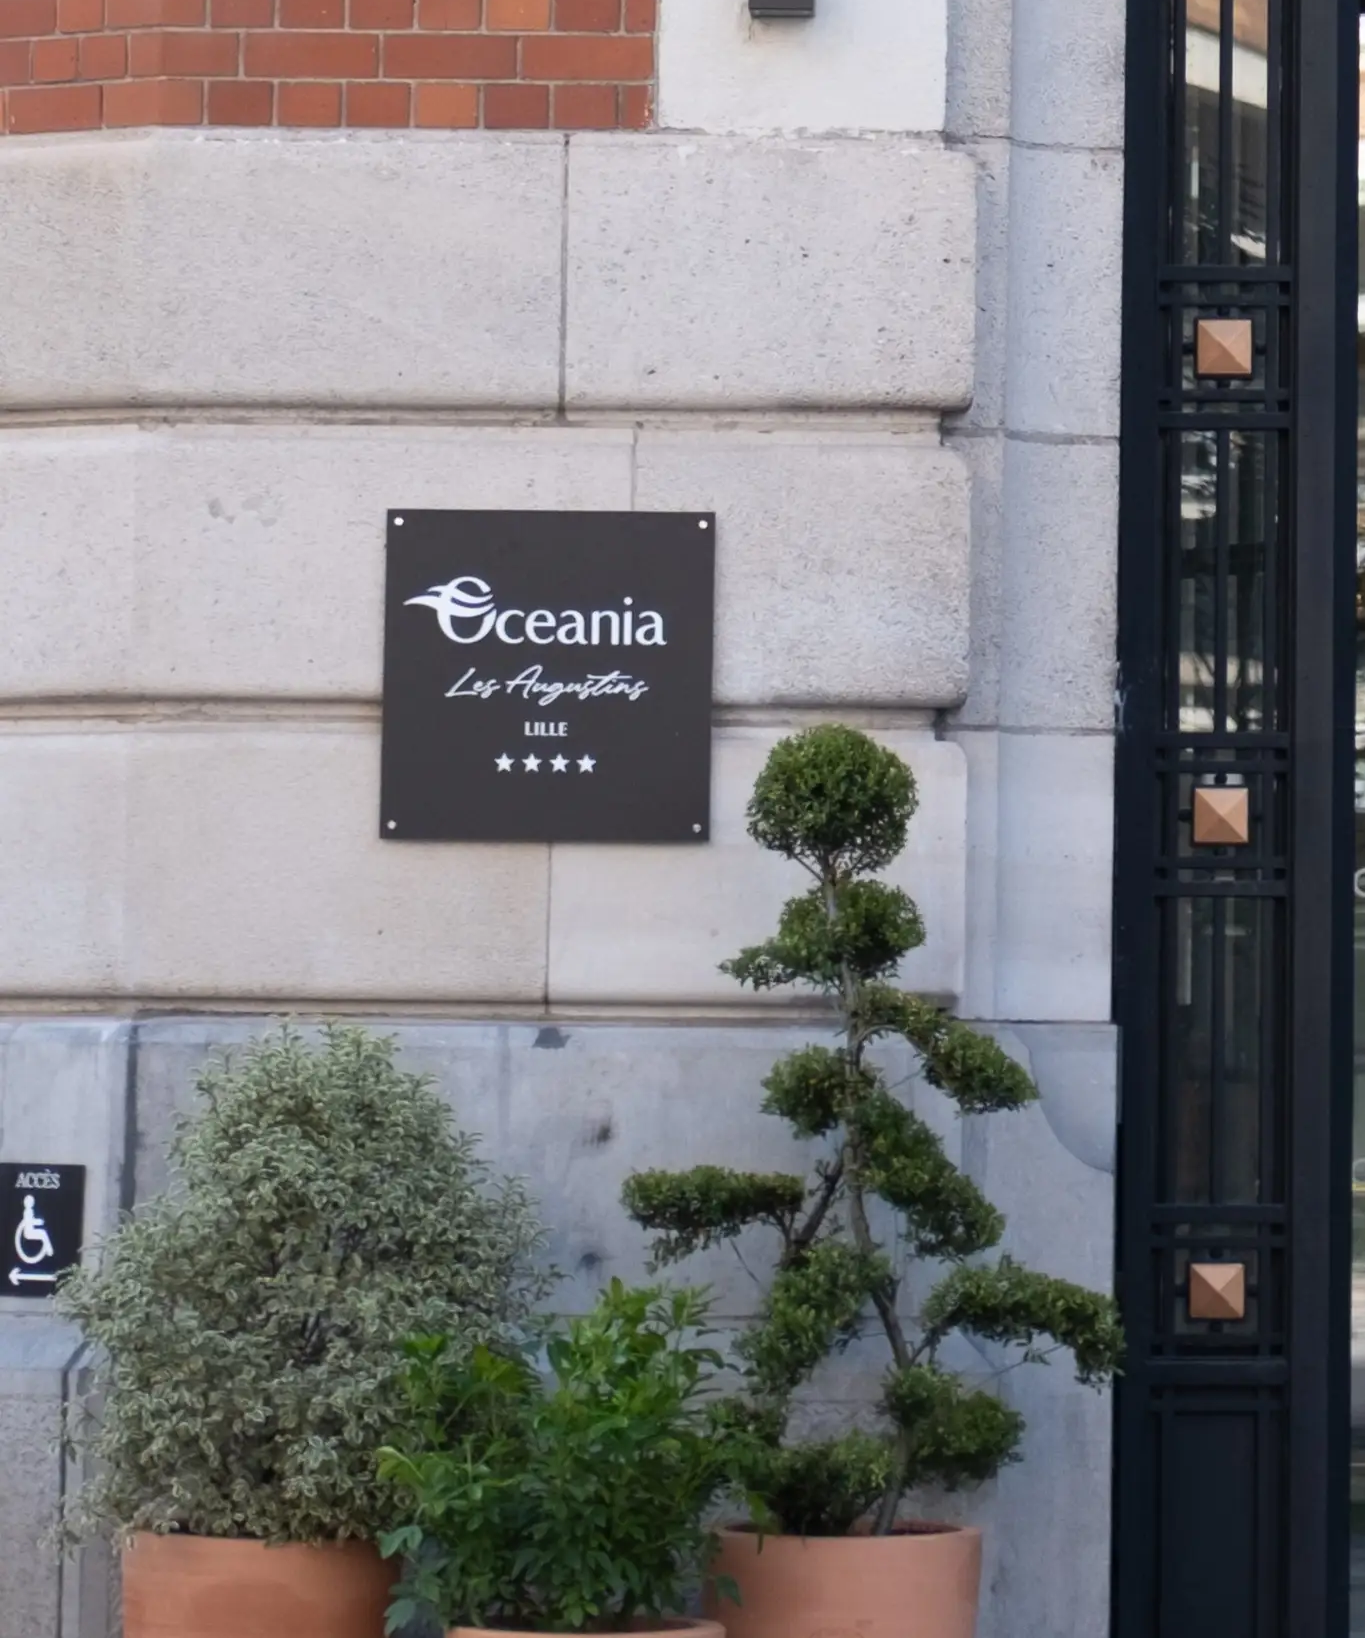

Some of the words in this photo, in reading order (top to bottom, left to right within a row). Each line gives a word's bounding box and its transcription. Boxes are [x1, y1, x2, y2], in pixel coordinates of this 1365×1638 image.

[402, 575, 668, 646] Oceania
[444, 667, 501, 699] Les
[504, 664, 650, 707] Augustins
[524, 721, 569, 737] LILLE
[14, 1168, 61, 1190] ACCÈS
